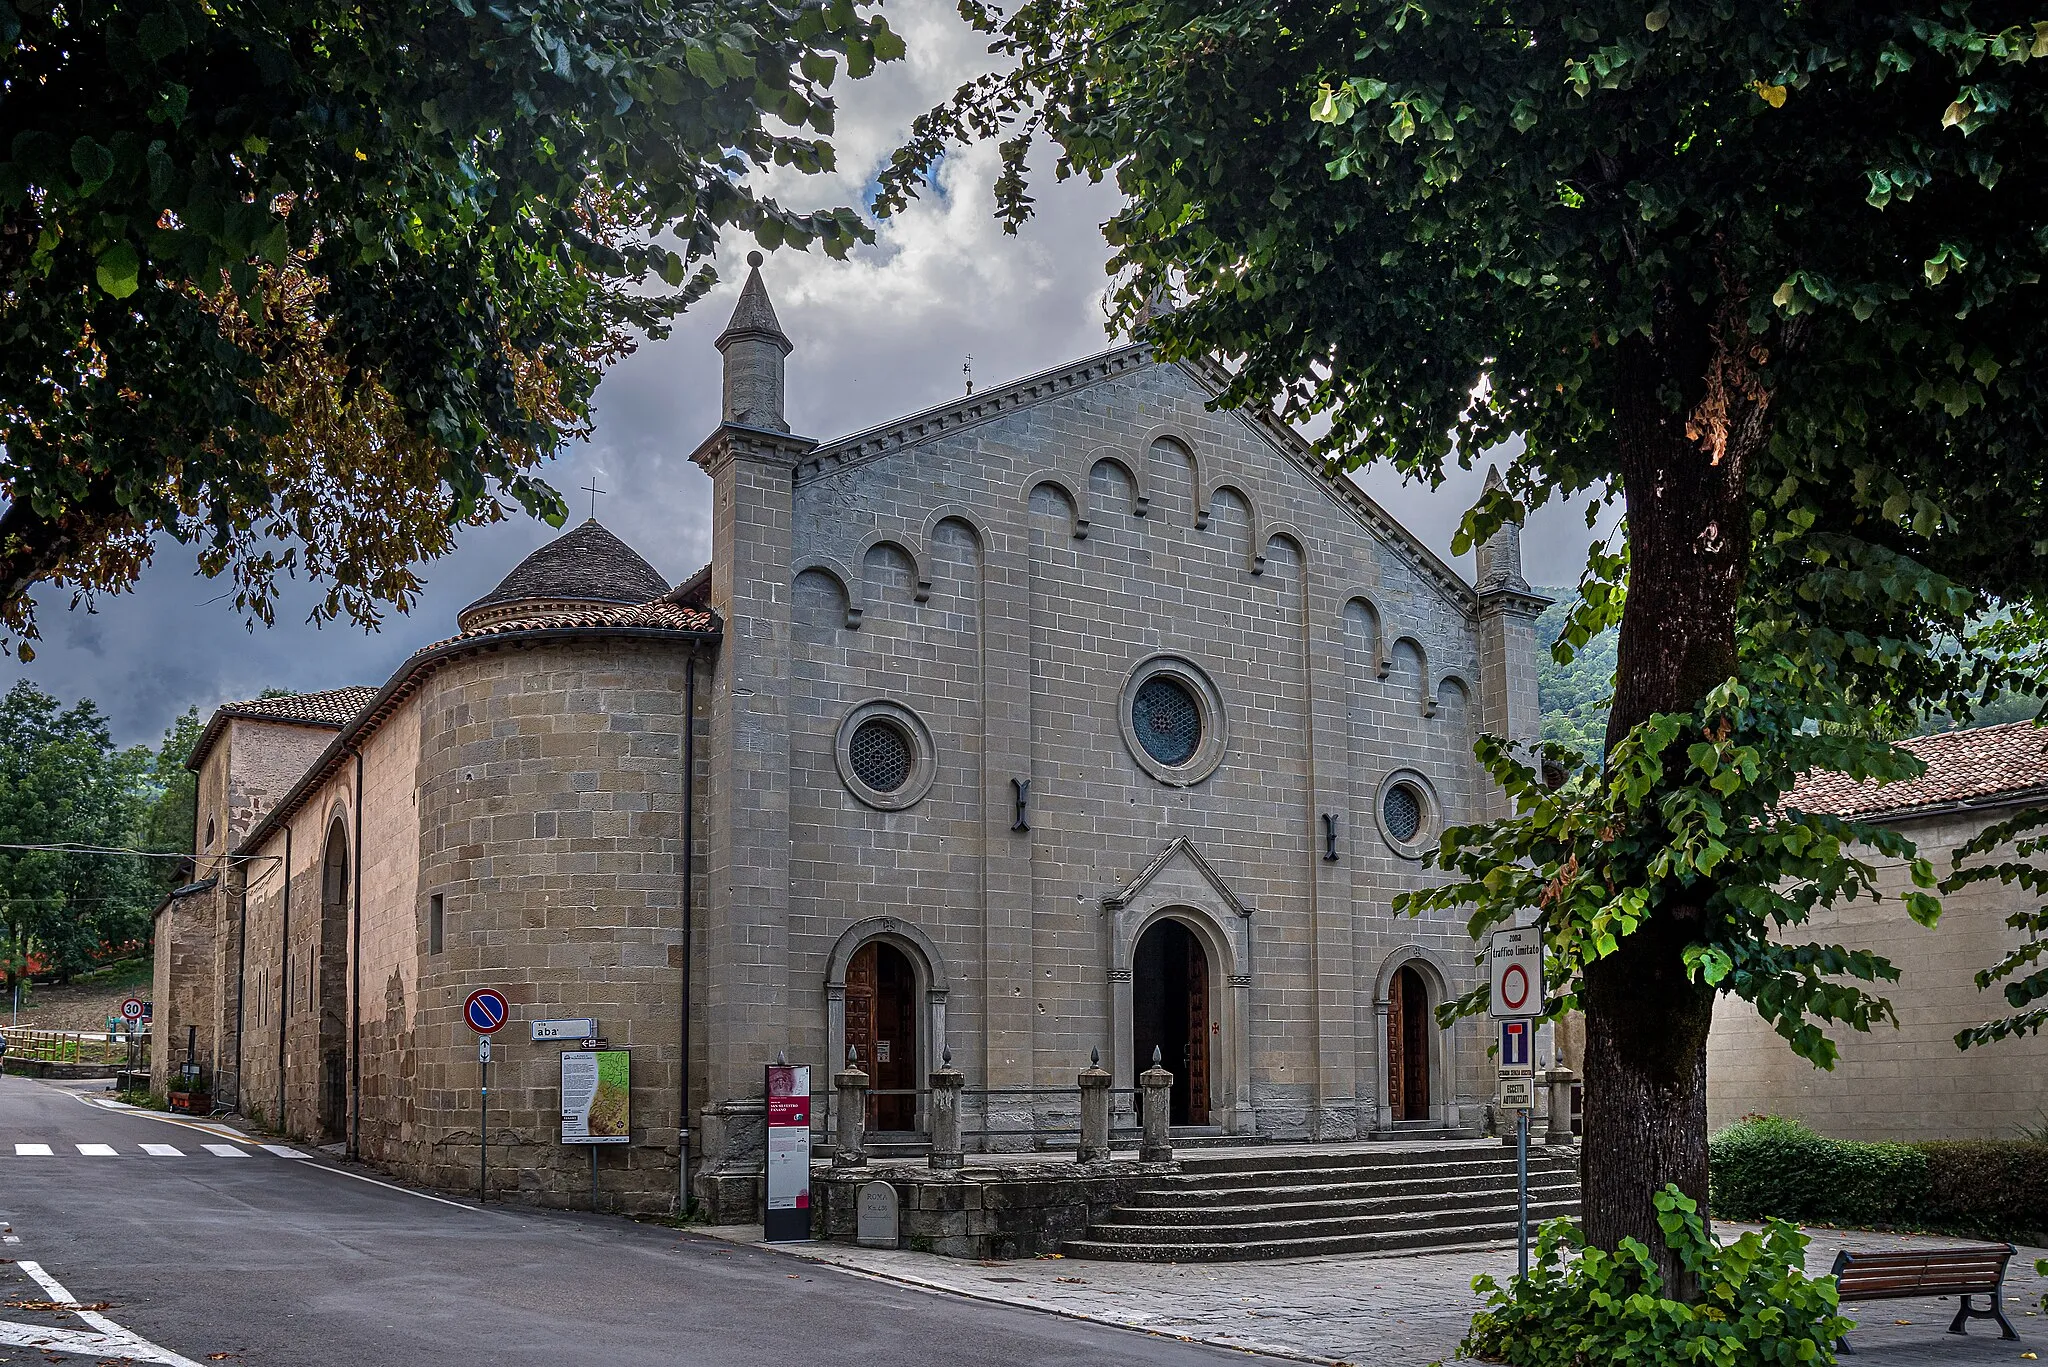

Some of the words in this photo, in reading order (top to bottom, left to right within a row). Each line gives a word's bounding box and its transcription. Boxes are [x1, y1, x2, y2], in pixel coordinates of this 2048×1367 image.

[1509, 934, 1522, 942] zona
[1493, 945, 1514, 958] traffico
[1515, 944, 1540, 955] limitato
[126, 1004, 139, 1014] 30
[1507, 1084, 1525, 1094] ECCETTO
[1503, 1095, 1529, 1104] AUTORIZZATI
